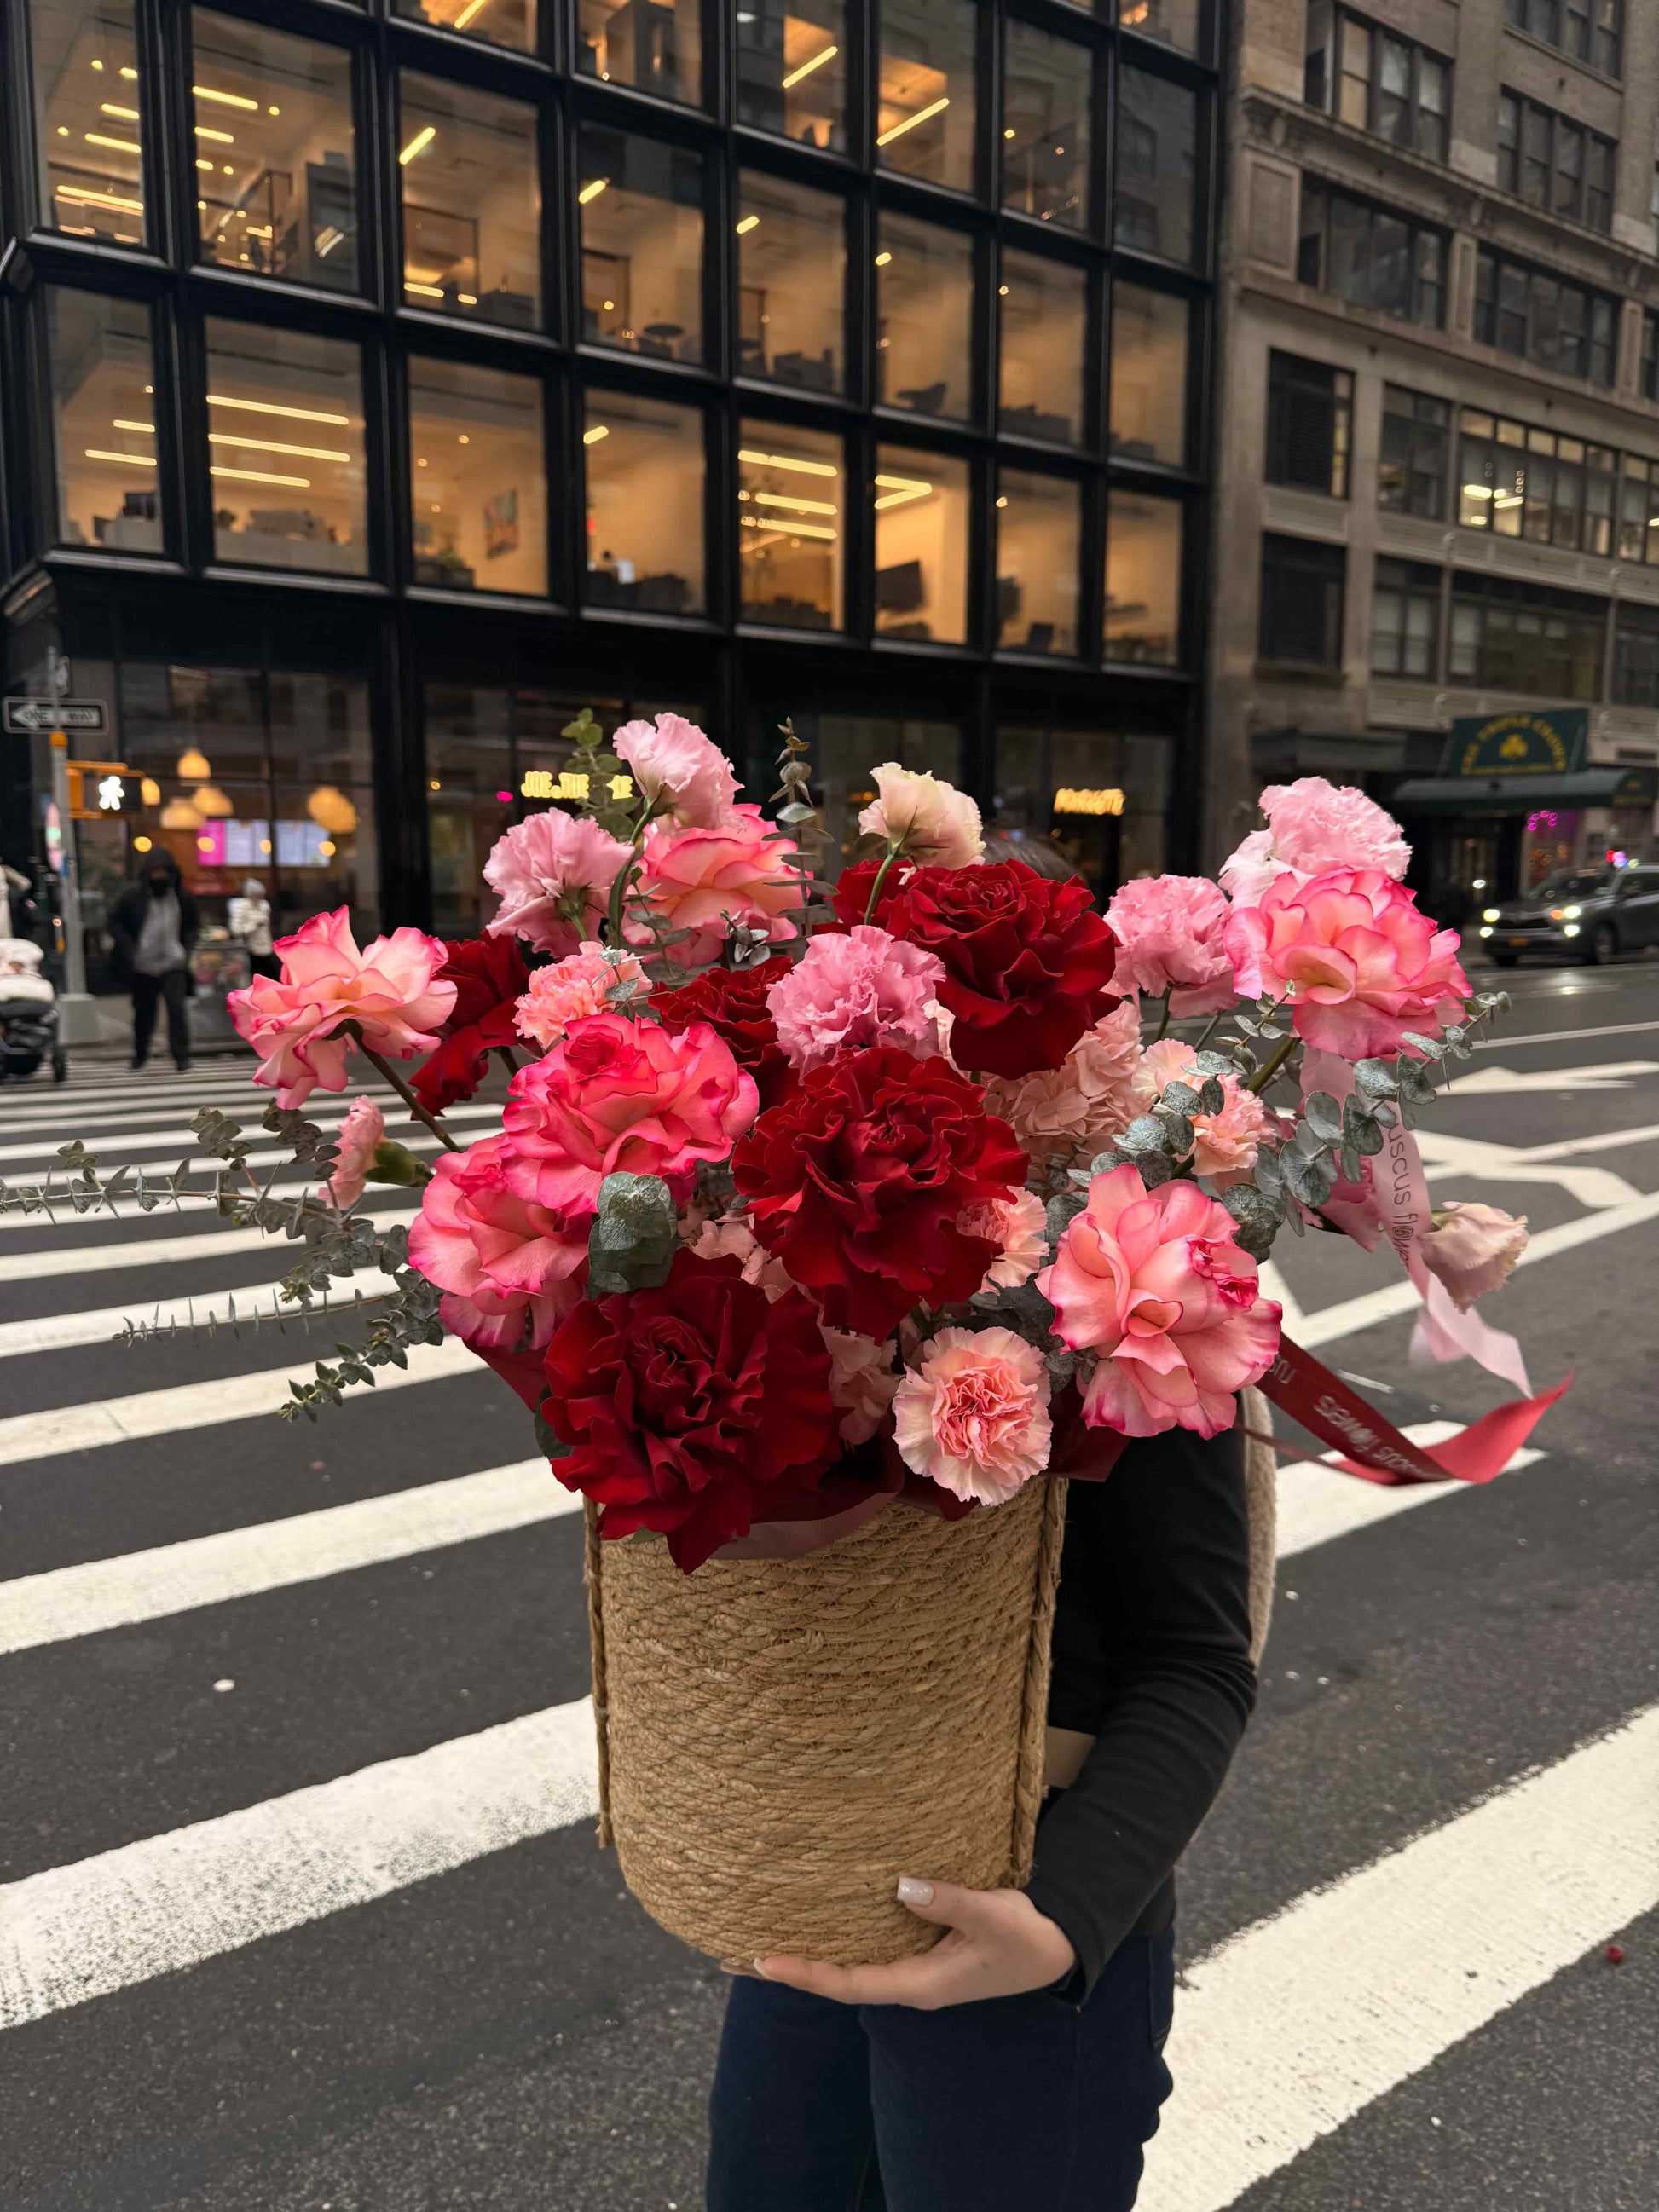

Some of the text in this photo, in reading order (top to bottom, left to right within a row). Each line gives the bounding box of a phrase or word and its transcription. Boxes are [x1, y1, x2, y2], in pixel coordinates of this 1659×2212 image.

[24, 707, 95, 723] ONE WAY
[1389, 1112, 1412, 1205] uscus
